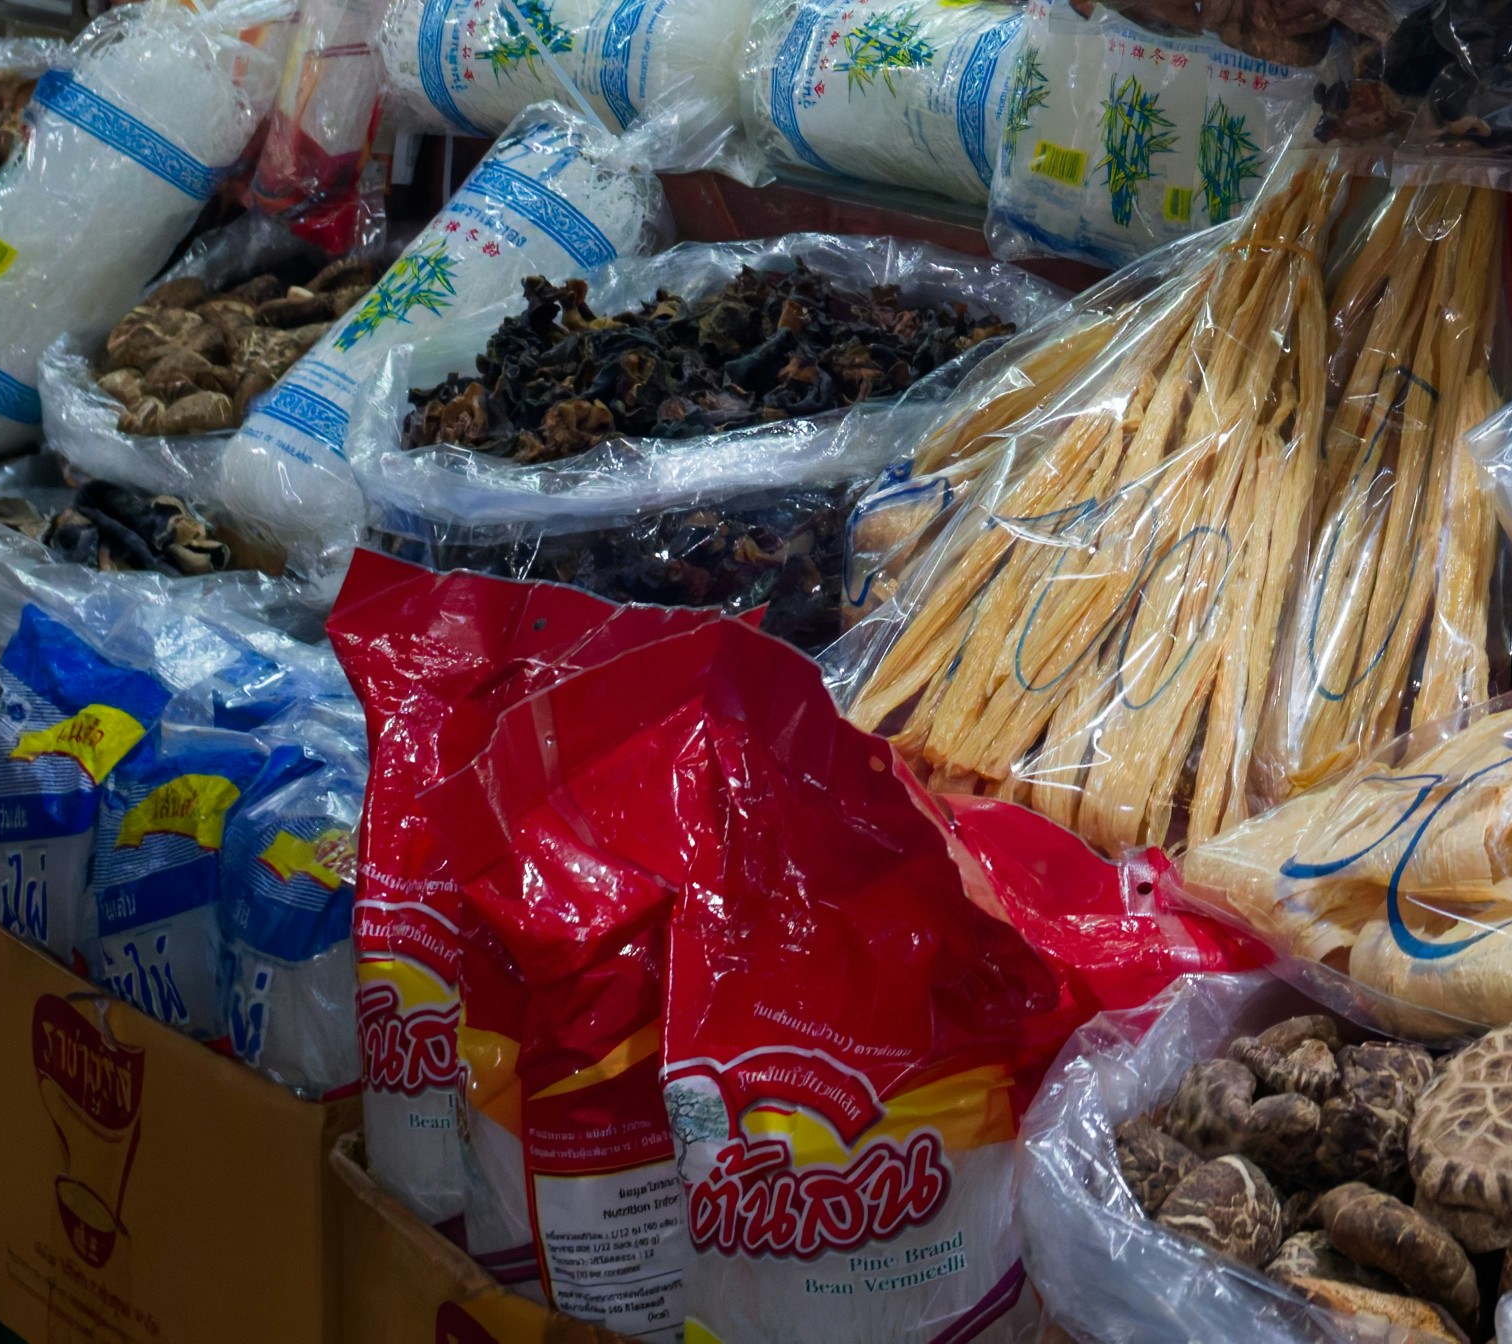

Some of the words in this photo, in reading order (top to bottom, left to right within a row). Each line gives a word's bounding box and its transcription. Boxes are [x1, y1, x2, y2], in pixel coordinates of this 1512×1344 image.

[40, 1018, 133, 1117] ราชาชูรส
[409, 1113, 451, 1130] Bean
[602, 1201, 652, 1221] Nutrition
[689, 1135, 947, 1258] ต้นสน
[849, 1255, 891, 1273] Pine
[905, 1230, 964, 1265] Brand
[805, 1277, 854, 1296] Bean
[863, 1252, 967, 1294] Vermicelli
